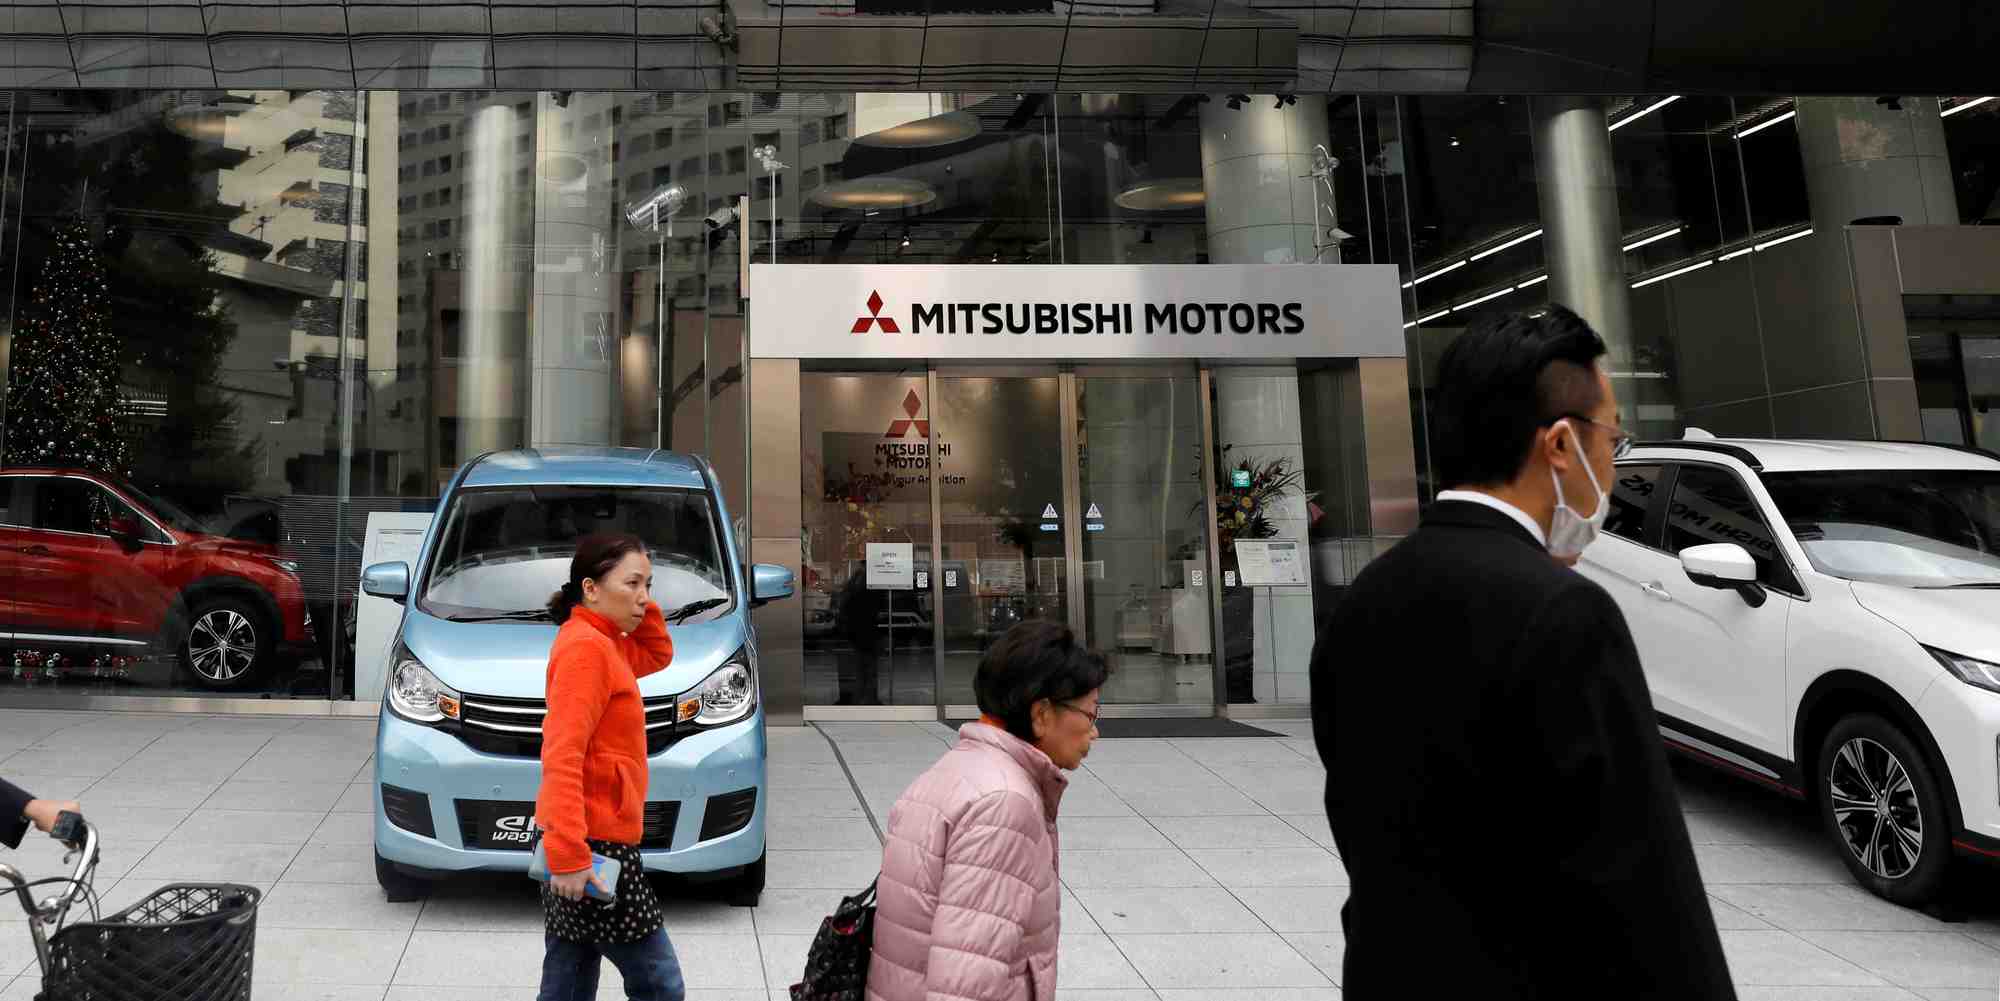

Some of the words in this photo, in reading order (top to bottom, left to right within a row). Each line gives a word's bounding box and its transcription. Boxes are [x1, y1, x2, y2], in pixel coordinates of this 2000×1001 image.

[911, 303, 1133, 335] MITSUBISHI
[1144, 303, 1306, 335] MOTORS
[875, 443, 951, 457] MITSUBIHI
[886, 457, 943, 469] MOTOR
[492, 831, 533, 843] wag
